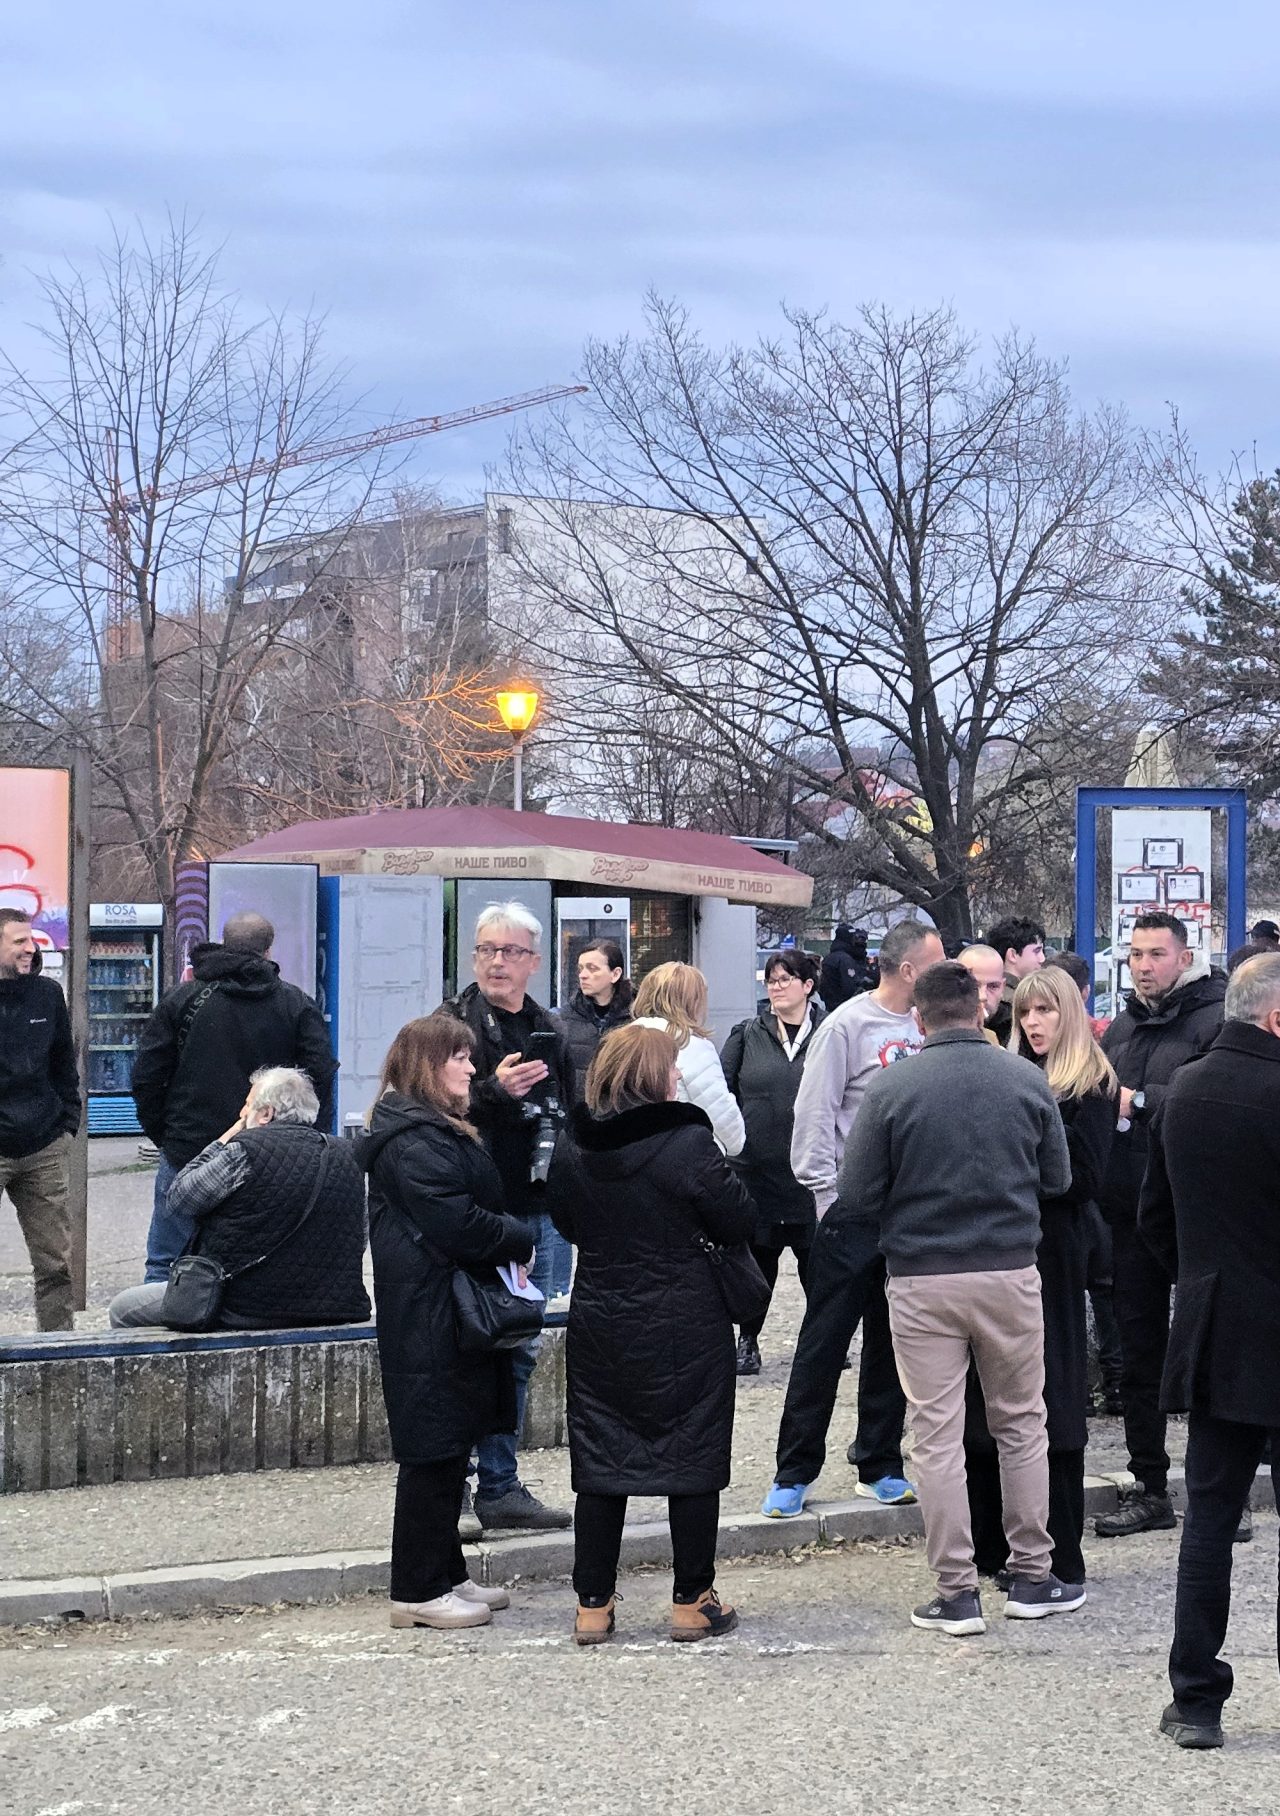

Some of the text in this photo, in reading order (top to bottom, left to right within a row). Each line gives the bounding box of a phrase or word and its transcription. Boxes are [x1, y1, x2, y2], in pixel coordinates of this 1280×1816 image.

[454, 856, 527, 869] НАШЕ ПИВО
[698, 874, 773, 894] НАШЕ ПИВО
[105, 904, 137, 916] ROSA
